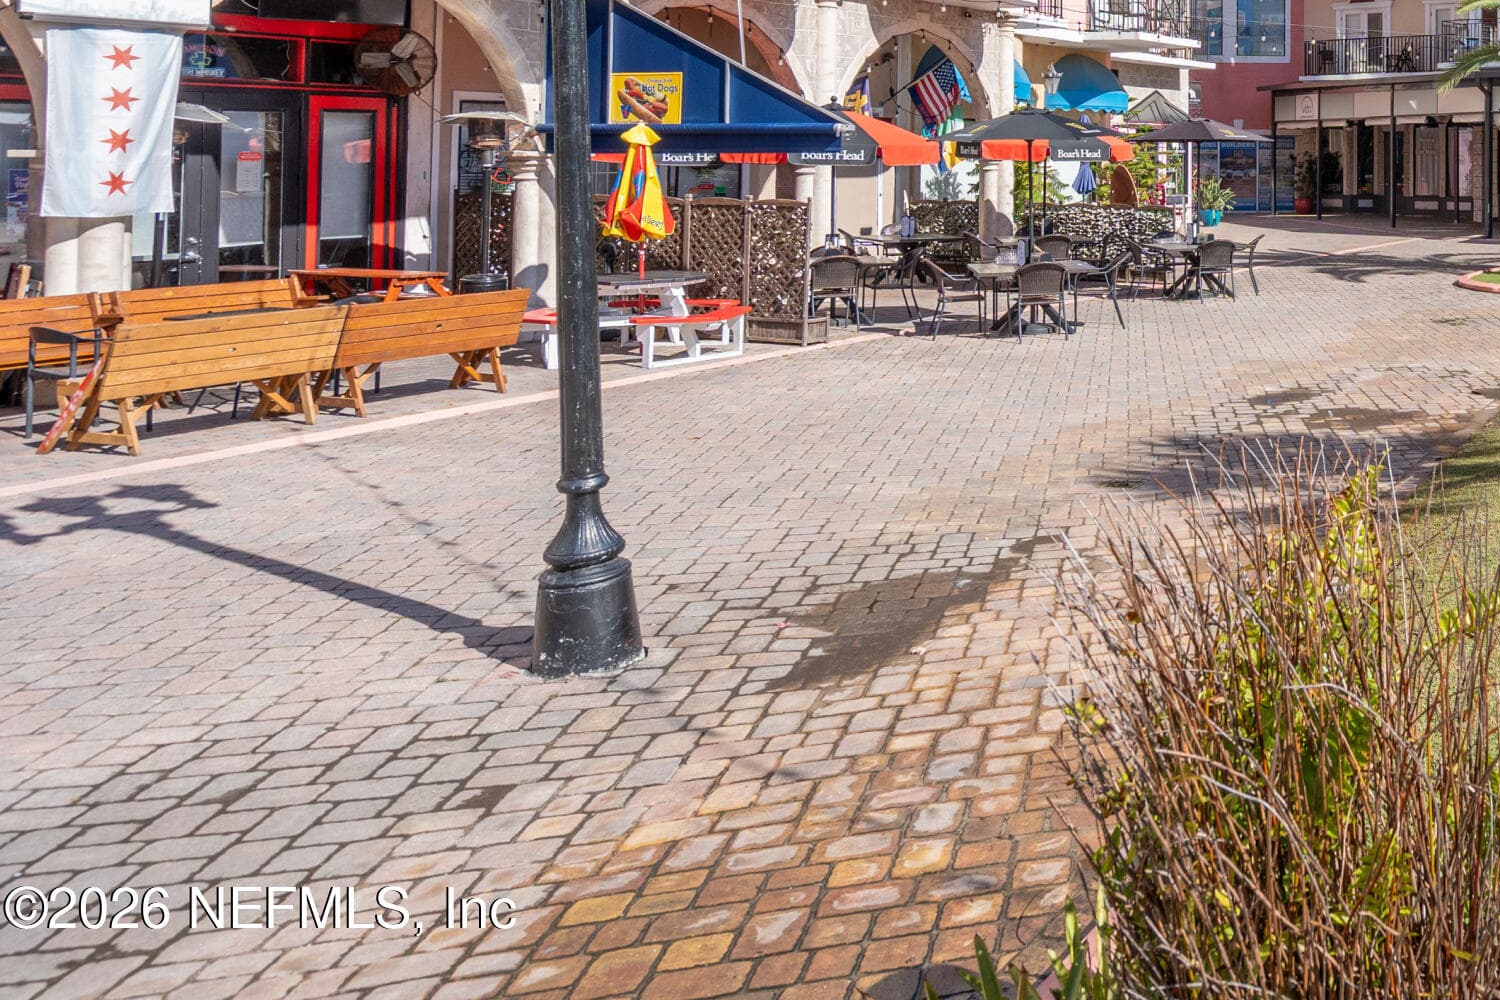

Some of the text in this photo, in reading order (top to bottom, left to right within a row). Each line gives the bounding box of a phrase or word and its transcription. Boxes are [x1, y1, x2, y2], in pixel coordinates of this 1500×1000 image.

[657, 83, 678, 95] Dogs
[836, 149, 865, 161] Head
[1057, 149, 1101, 158] Boar's Head
